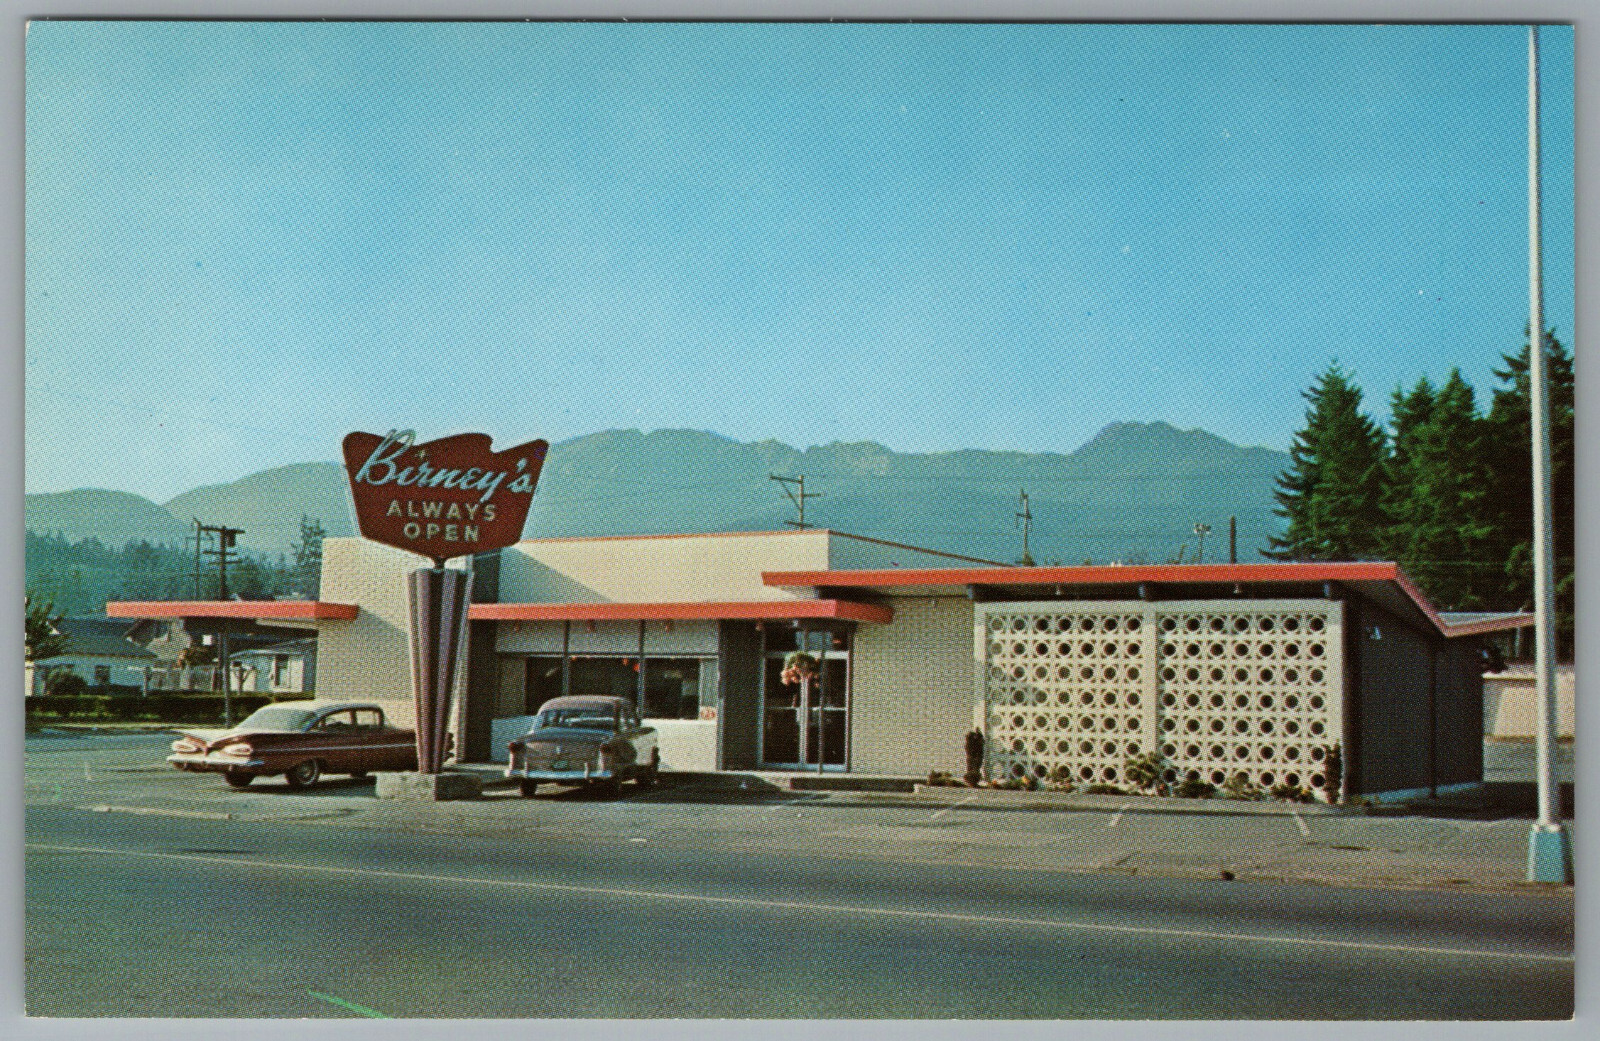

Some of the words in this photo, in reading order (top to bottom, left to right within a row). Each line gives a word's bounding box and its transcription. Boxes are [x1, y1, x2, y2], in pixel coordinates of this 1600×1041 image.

[354, 428, 532, 502] Birney's
[386, 500, 497, 522] ALWAYS
[403, 522, 480, 542] OPEN
